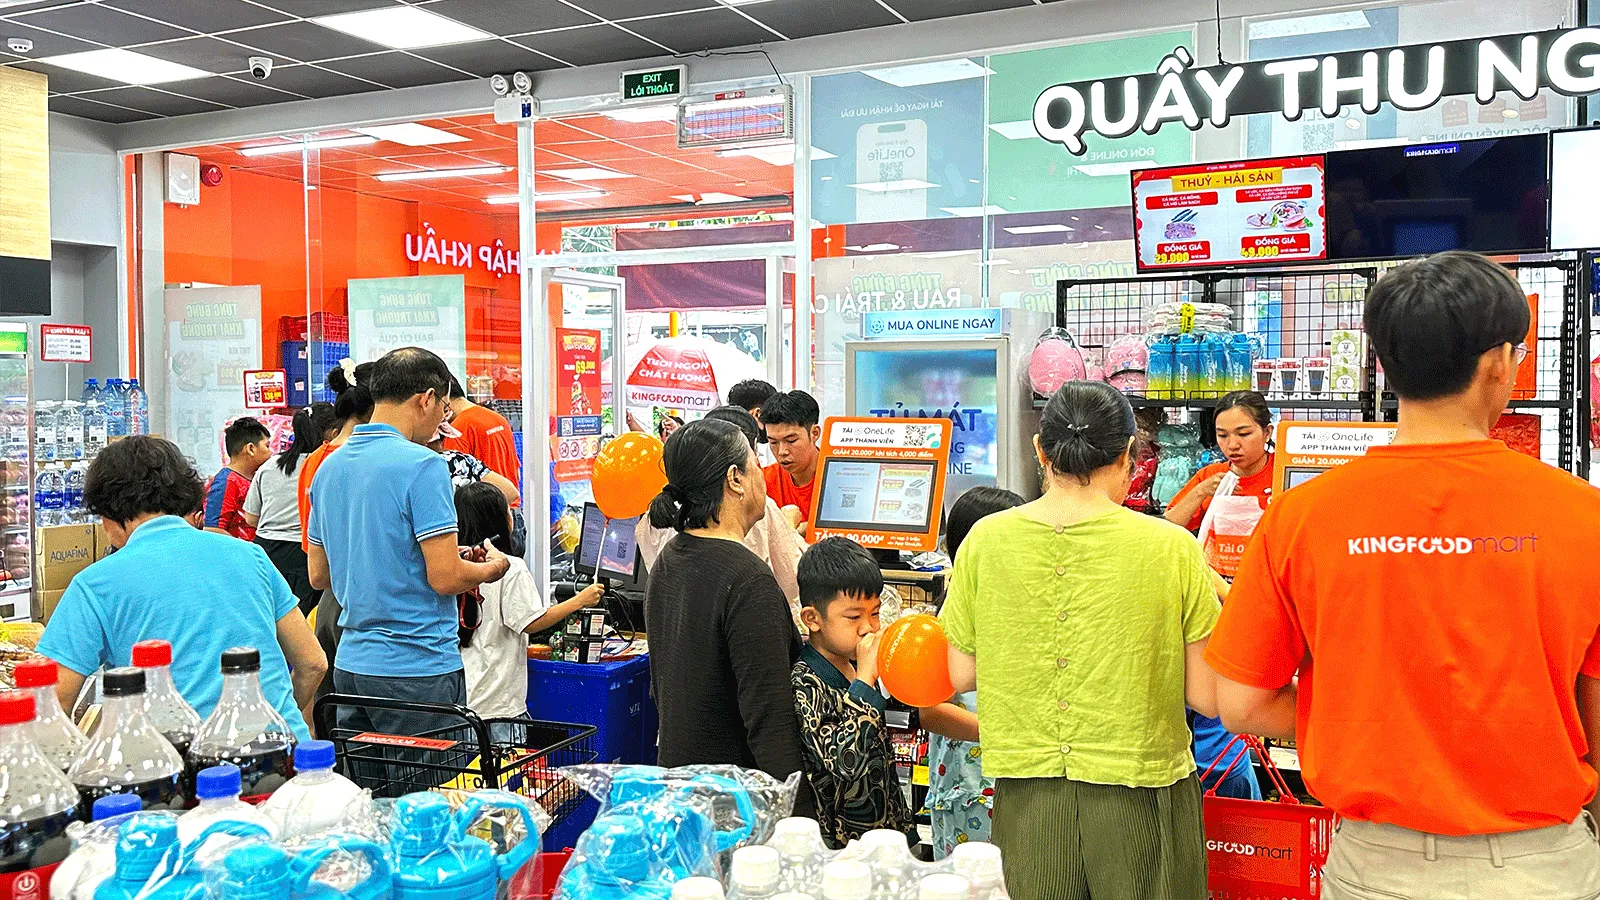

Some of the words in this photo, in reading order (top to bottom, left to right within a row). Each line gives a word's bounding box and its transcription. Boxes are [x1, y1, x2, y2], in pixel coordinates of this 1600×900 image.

[643, 74, 662, 84] EXIT
[647, 84, 675, 95] THOÁT
[1036, 47, 1244, 154] QUẦY
[1264, 46, 1444, 121] THU
[1281, 236, 1296, 245] GIÁ
[1189, 242, 1203, 251] GIÁ
[1241, 245, 1279, 258] 49.000
[1154, 252, 1190, 264] 29.000
[887, 321, 914, 331] MUA
[916, 319, 959, 330] ONLINE
[962, 318, 996, 329] NGAY
[674, 361, 709, 370] NGON
[632, 392, 711, 407] KINGFOODmart
[863, 427, 896, 435] OneLife
[1331, 432, 1374, 442] OneLife
[1320, 443, 1351, 451] THÀNH
[1353, 443, 1367, 452] VIÊ
[1291, 455, 1317, 465] GIẢM
[1348, 533, 1539, 555] KINGFOODmart
[50, 548, 90, 562] AQUAFINA
[1206, 840, 1292, 860] GFOODmart
